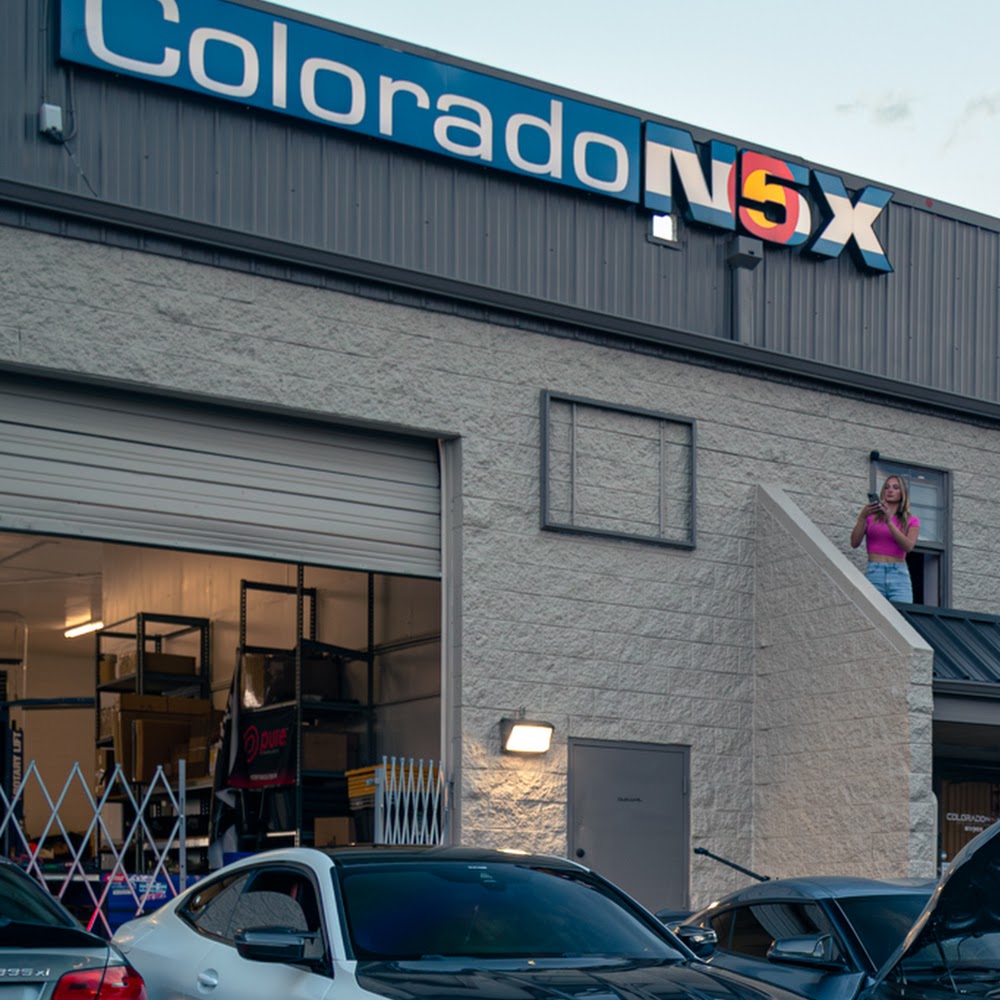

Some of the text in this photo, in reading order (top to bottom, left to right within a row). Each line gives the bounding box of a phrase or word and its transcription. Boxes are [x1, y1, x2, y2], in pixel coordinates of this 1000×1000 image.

[85, 0, 630, 193] Colorado
[12, 730, 22, 752] LIFT
[260, 727, 288, 752] pure
